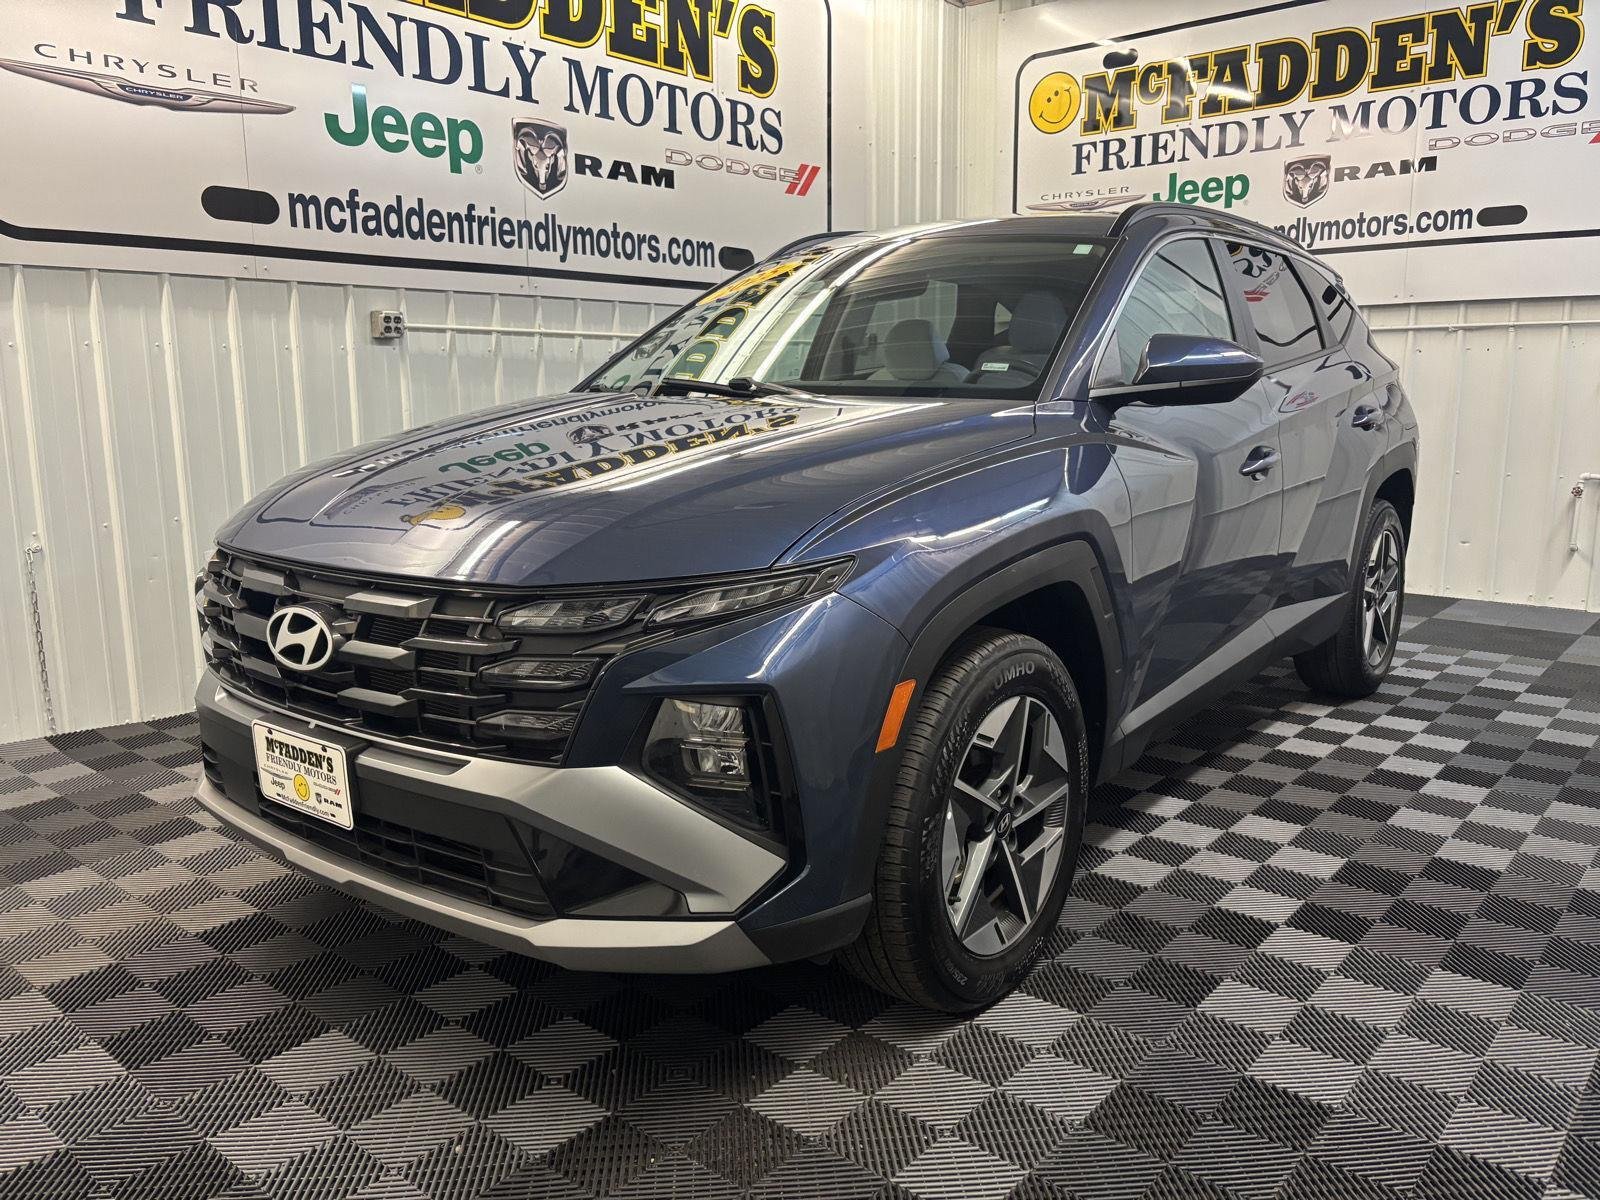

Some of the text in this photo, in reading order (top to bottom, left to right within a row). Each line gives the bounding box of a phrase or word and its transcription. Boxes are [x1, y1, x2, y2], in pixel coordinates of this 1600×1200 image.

[33, 42, 260, 93] CHRYSLER
[125, 86, 184, 100] CHRYSLER
[562, 57, 783, 155] MOTORS
[323, 82, 484, 175] Jeep
[1071, 70, 1589, 176] FRIENDLY MOTORS
[1428, 120, 1600, 151] DODGE
[574, 153, 675, 189] RAM
[665, 148, 801, 184] DODGE
[1334, 156, 1438, 182] RAM
[1040, 185, 1130, 201] CHRYSLER
[1152, 172, 1250, 208] Jeep
[287, 187, 715, 269] mcfaddenfriendlymotors.com
[266, 752, 338, 785] FRIENDLY MOTORS
